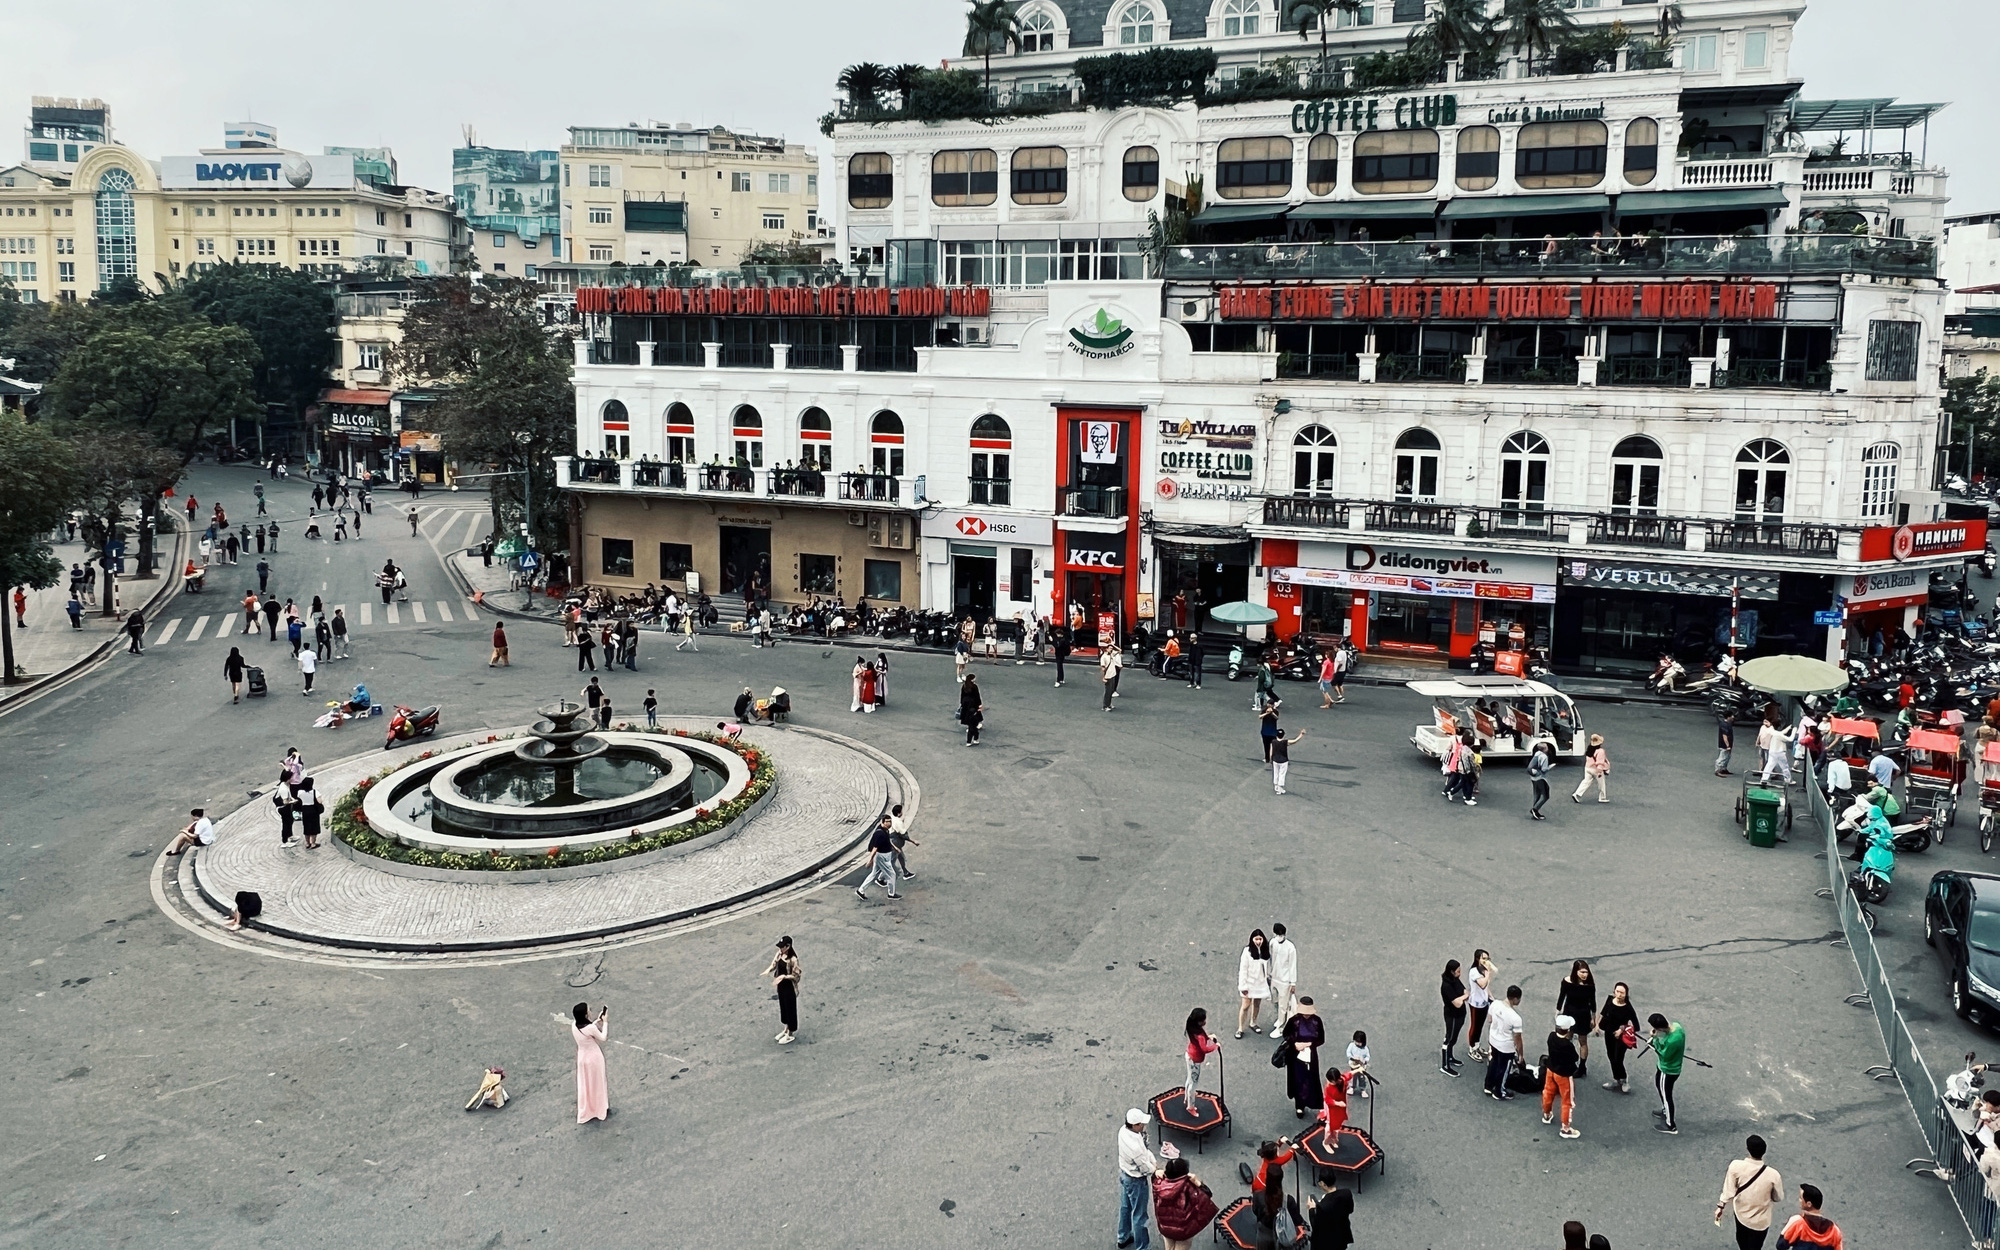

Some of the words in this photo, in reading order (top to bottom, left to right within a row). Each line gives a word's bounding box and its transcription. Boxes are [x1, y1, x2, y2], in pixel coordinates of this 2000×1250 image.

[1292, 100, 1378, 133] COFFEE
[1395, 94, 1458, 129] CLUB
[1535, 101, 1604, 121] Restaurant
[196, 163, 281, 181] BAOVIET
[854, 287, 890, 316] NAM
[1440, 286, 1490, 318] NAM
[1496, 285, 1571, 321] QUANG
[1580, 285, 1634, 318] VINH
[1067, 341, 1135, 359] PHYTOPHARCO
[1161, 452, 1212, 469] COFFEE
[1217, 453, 1253, 471] CLUB
[989, 523, 1017, 534] HSBC
[1067, 549, 1117, 568] KFC
[1595, 567, 1672, 586] VERTU
[1870, 571, 1917, 590] SeABank
[1277, 583, 1292, 593] 03
